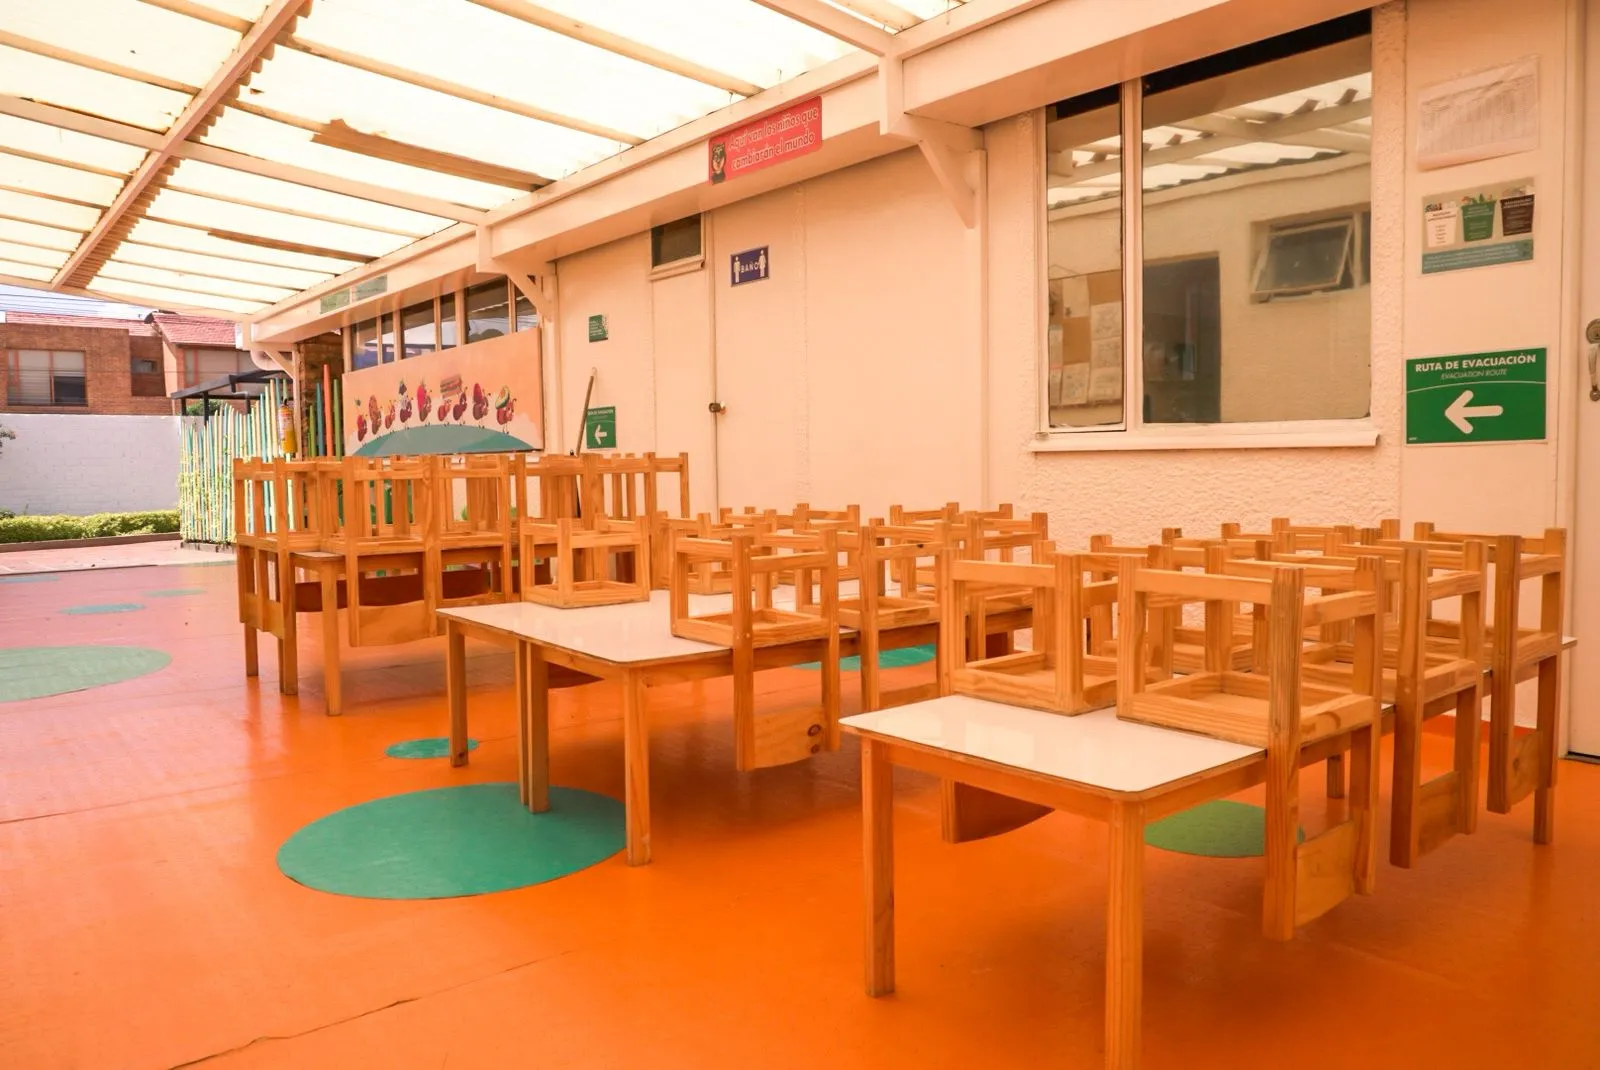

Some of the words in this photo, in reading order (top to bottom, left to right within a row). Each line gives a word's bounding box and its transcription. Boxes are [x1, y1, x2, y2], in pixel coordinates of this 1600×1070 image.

[764, 121, 776, 136] los
[800, 107, 819, 127] que
[774, 138, 783, 155] el
[784, 128, 816, 151] mundo
[1415, 362, 1442, 373] RUTA
[1445, 360, 1459, 370] DE
[1462, 353, 1537, 369] EVACUACIÓN
[1441, 370, 1484, 380] EVACUATION
[1485, 368, 1508, 377] ROUTE
